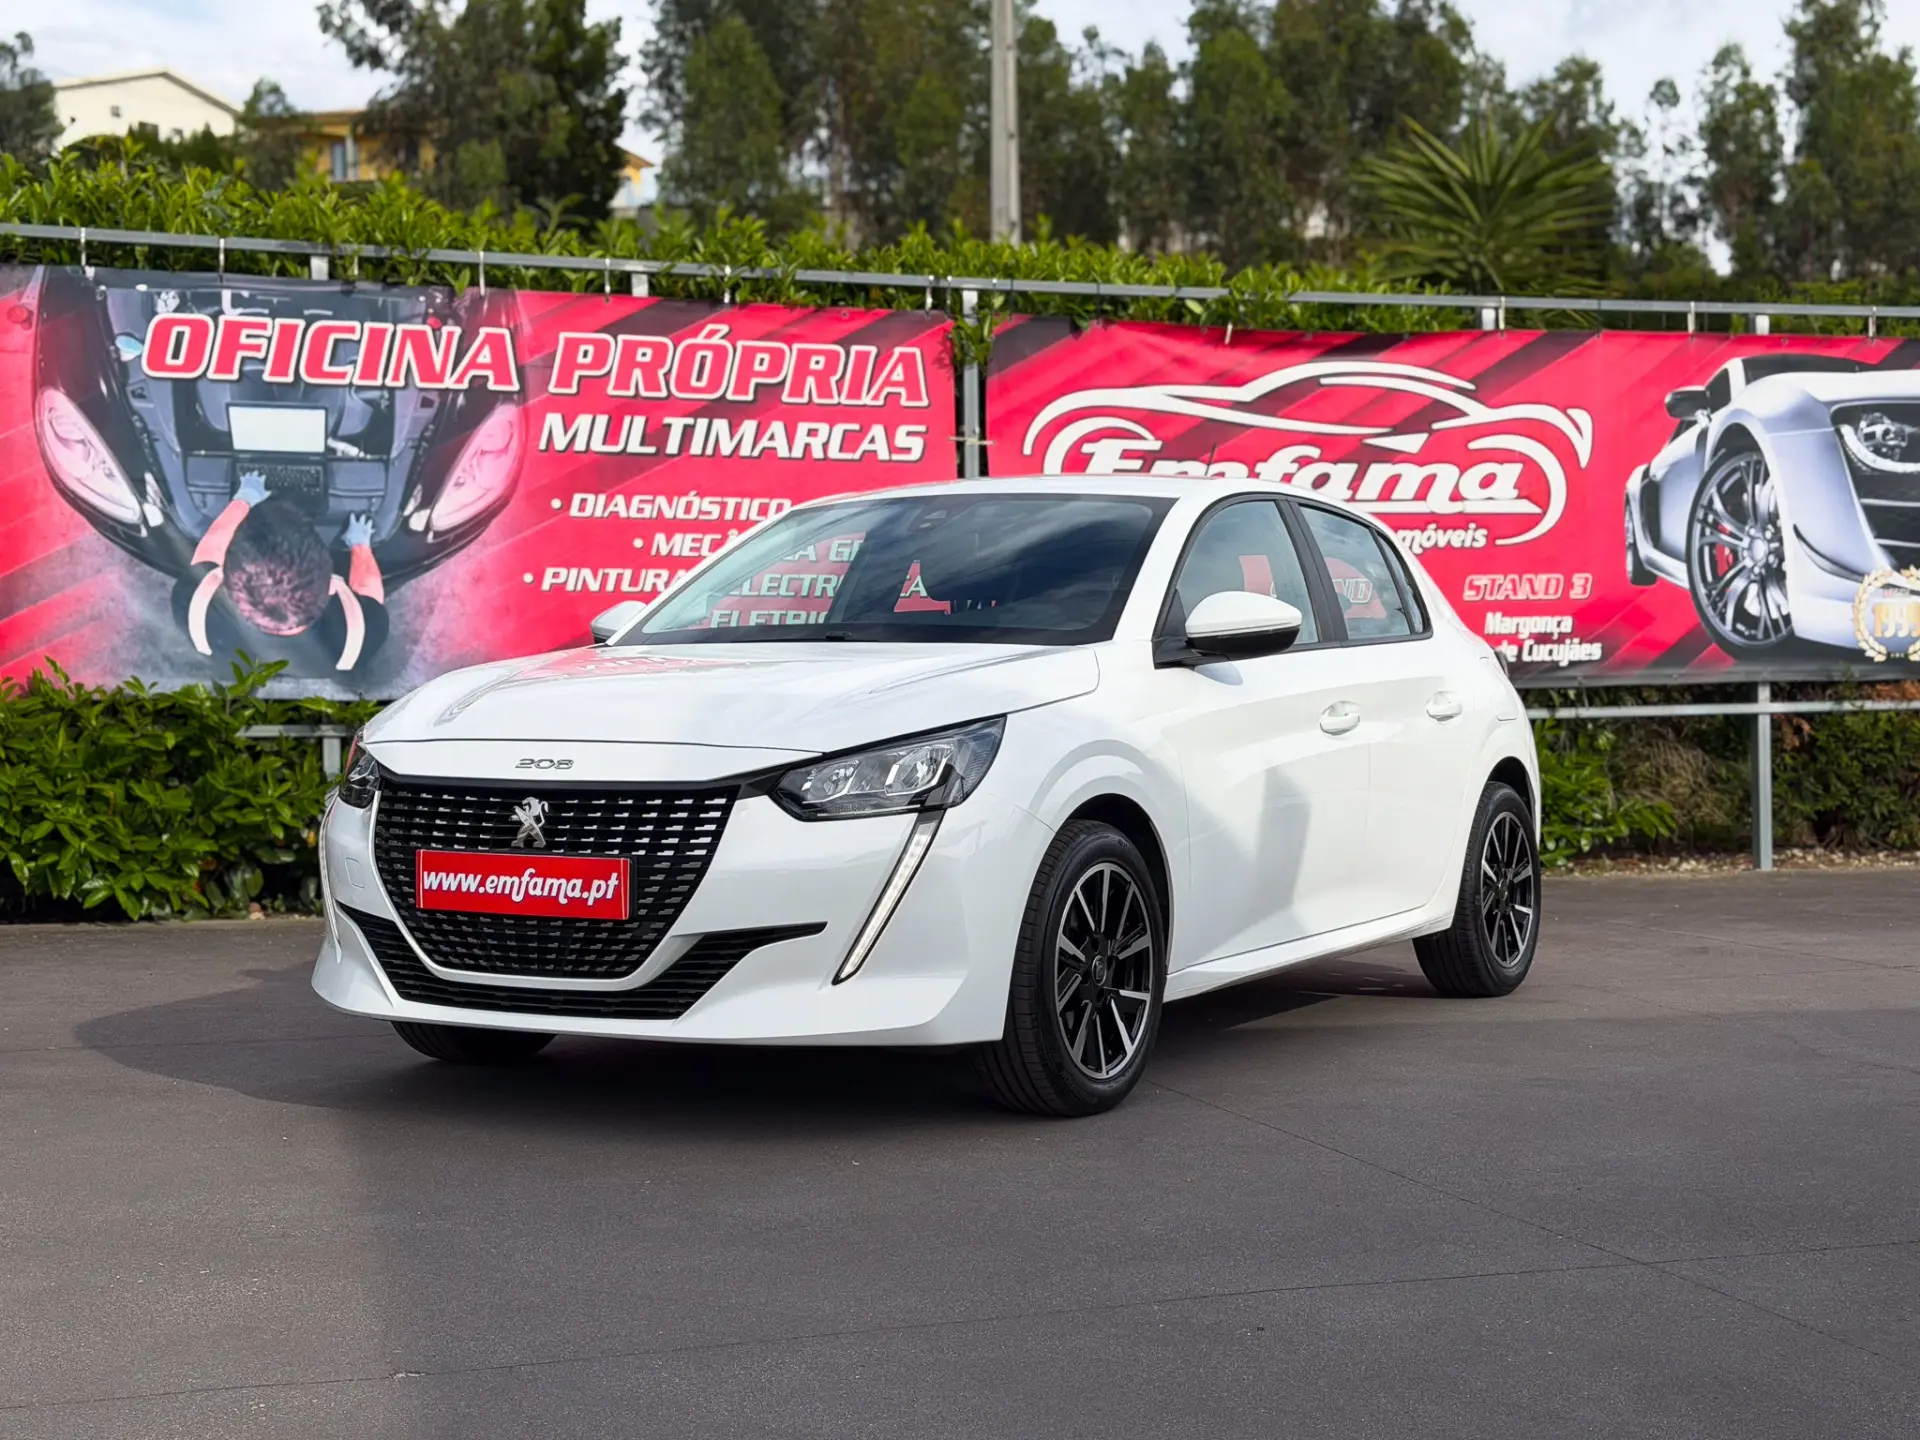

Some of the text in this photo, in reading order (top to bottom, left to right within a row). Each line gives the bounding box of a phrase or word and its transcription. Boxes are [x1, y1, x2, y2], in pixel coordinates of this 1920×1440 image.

[142, 314, 929, 407] OFICINA PRÓPRIA
[539, 413, 927, 462] MULTIMARCAS
[1396, 522, 1489, 555] móveis
[1463, 573, 1593, 601] STAND 3
[1484, 611, 1573, 640] Margonça
[515, 758, 574, 770] 208
[423, 867, 618, 906] www.emfama.pt
